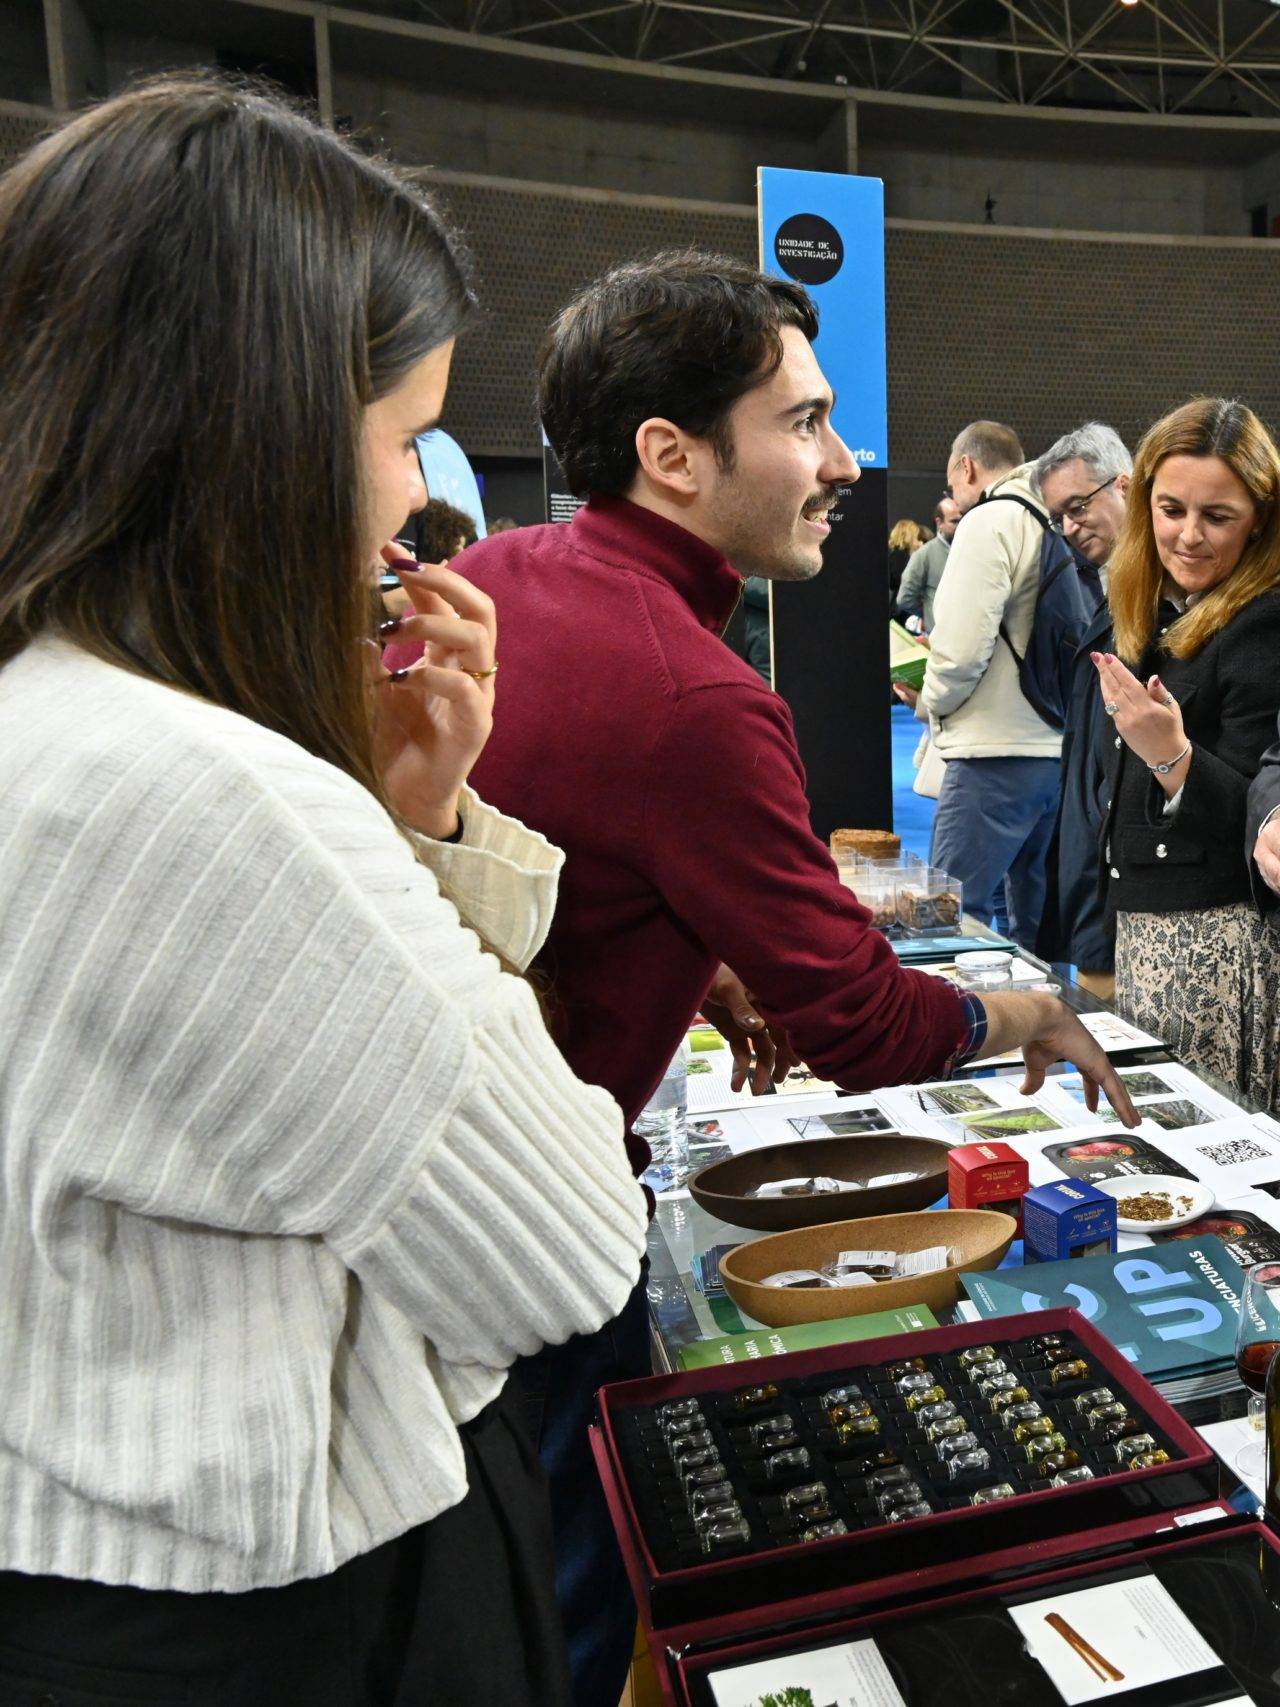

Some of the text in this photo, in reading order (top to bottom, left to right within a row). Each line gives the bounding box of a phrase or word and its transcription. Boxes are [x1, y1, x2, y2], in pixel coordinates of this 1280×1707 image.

[778, 238, 830, 250] UNIDADE DE
[778, 249, 838, 260] INVESTIGAÇÃO
[853, 448, 876, 462] rto
[1114, 1259, 1223, 1341] UP
